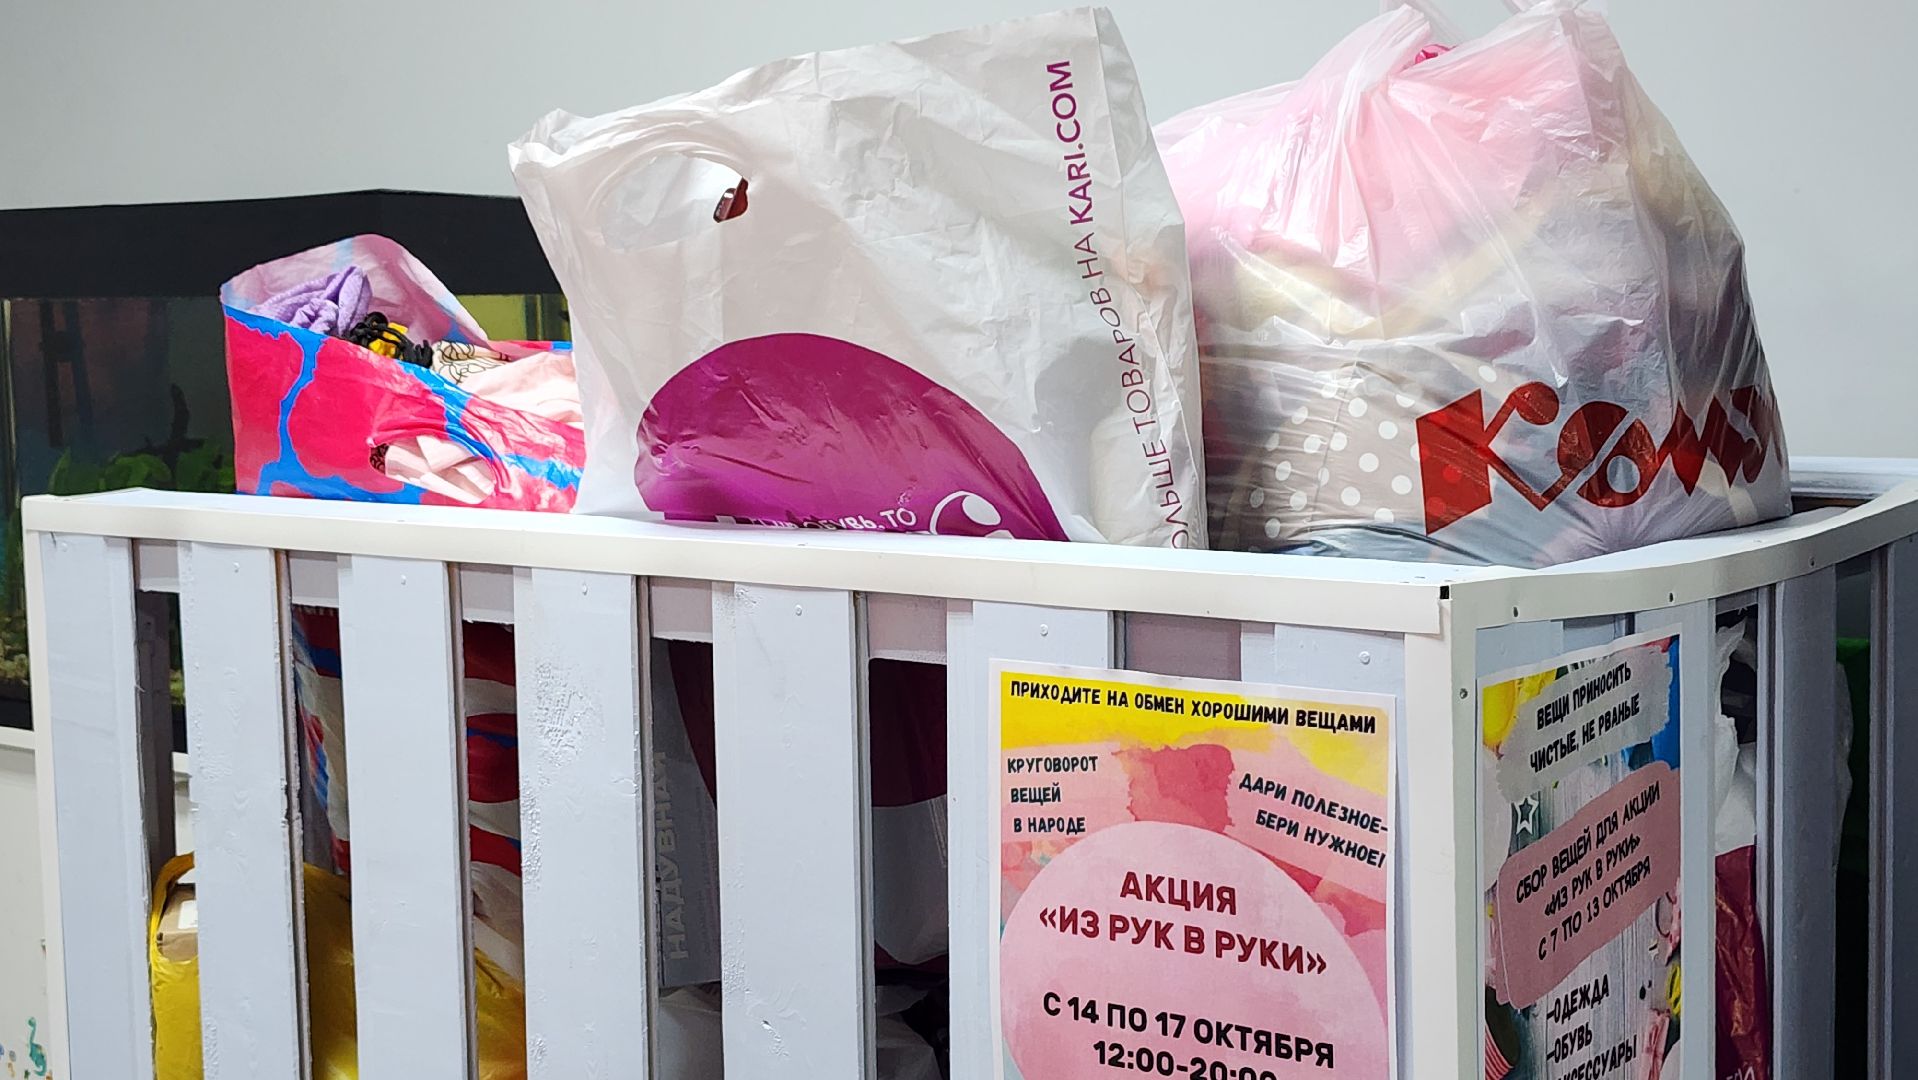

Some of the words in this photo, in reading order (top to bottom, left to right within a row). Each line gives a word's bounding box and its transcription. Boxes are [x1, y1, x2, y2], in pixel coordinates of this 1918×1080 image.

[1046, 60, 1093, 225] KARI.COM
[1074, 232, 1103, 279] НА
[1090, 287, 1156, 434] ТОВАРОВ
[1142, 439, 1189, 549] ОЛЬШЕ
[1011, 681, 1100, 705] ПРИХОДИТЕ
[1107, 690, 1129, 707] НА
[1134, 692, 1185, 715] ОБМЕН
[1190, 700, 1289, 726] ХОРОШИМИ
[1296, 710, 1377, 734] ВЕЩАМИ
[1536, 693, 1570, 730] ВЕЩИ
[1572, 661, 1632, 711] ПРИНОСИТЬ
[1007, 756, 1098, 774] КРУГОВОРОТ
[1530, 730, 1579, 773] ЧИСТЫЕ,
[1582, 719, 1596, 746] НЕ
[1598, 692, 1640, 737] РВАНЫЕ
[1010, 782, 1061, 805] ВЕЩЕЙ
[1013, 818, 1022, 833] В
[1027, 817, 1086, 836] НАРОДЕ
[1238, 772, 1287, 801] ДАРИ
[1291, 789, 1389, 835] ПОЛЕЗНОЕ-
[1255, 809, 1299, 838] БЕРИ
[1304, 827, 1387, 869] НУЖНОЕ!
[1516, 864, 1547, 904] СБОР
[1552, 825, 1591, 879] ВЕЩЕЙ
[1596, 810, 1618, 849] ДЛЯ
[1623, 780, 1660, 825] АКЦИИ
[1120, 871, 1237, 916] АКЦИЯ
[1538, 937, 1547, 960] С
[1550, 927, 1558, 952] 7
[1561, 911, 1582, 942] ПО
[1586, 896, 1600, 923] 13
[1603, 855, 1651, 909] ОКТЯБРЯ
[1544, 886, 1568, 916] «ИЗ
[1571, 866, 1593, 899] РУК
[1595, 858, 1603, 881] В
[1606, 833, 1641, 871] РУКИ»
[1039, 905, 1100, 939] «ИЗ
[1109, 914, 1174, 950] РУК
[1184, 926, 1205, 954] В
[1215, 932, 1327, 975] РУКИ»
[1043, 992, 1061, 1017] С
[1068, 996, 1099, 1024] 14
[1107, 1003, 1147, 1033] ПО
[1155, 1012, 1186, 1038] 17
[1193, 1019, 1335, 1069] ОКТЯБРЯ
[1546, 974, 1609, 1025] -ОДЕЖДА
[1546, 1022, 1593, 1063] -ОБУВЬ
